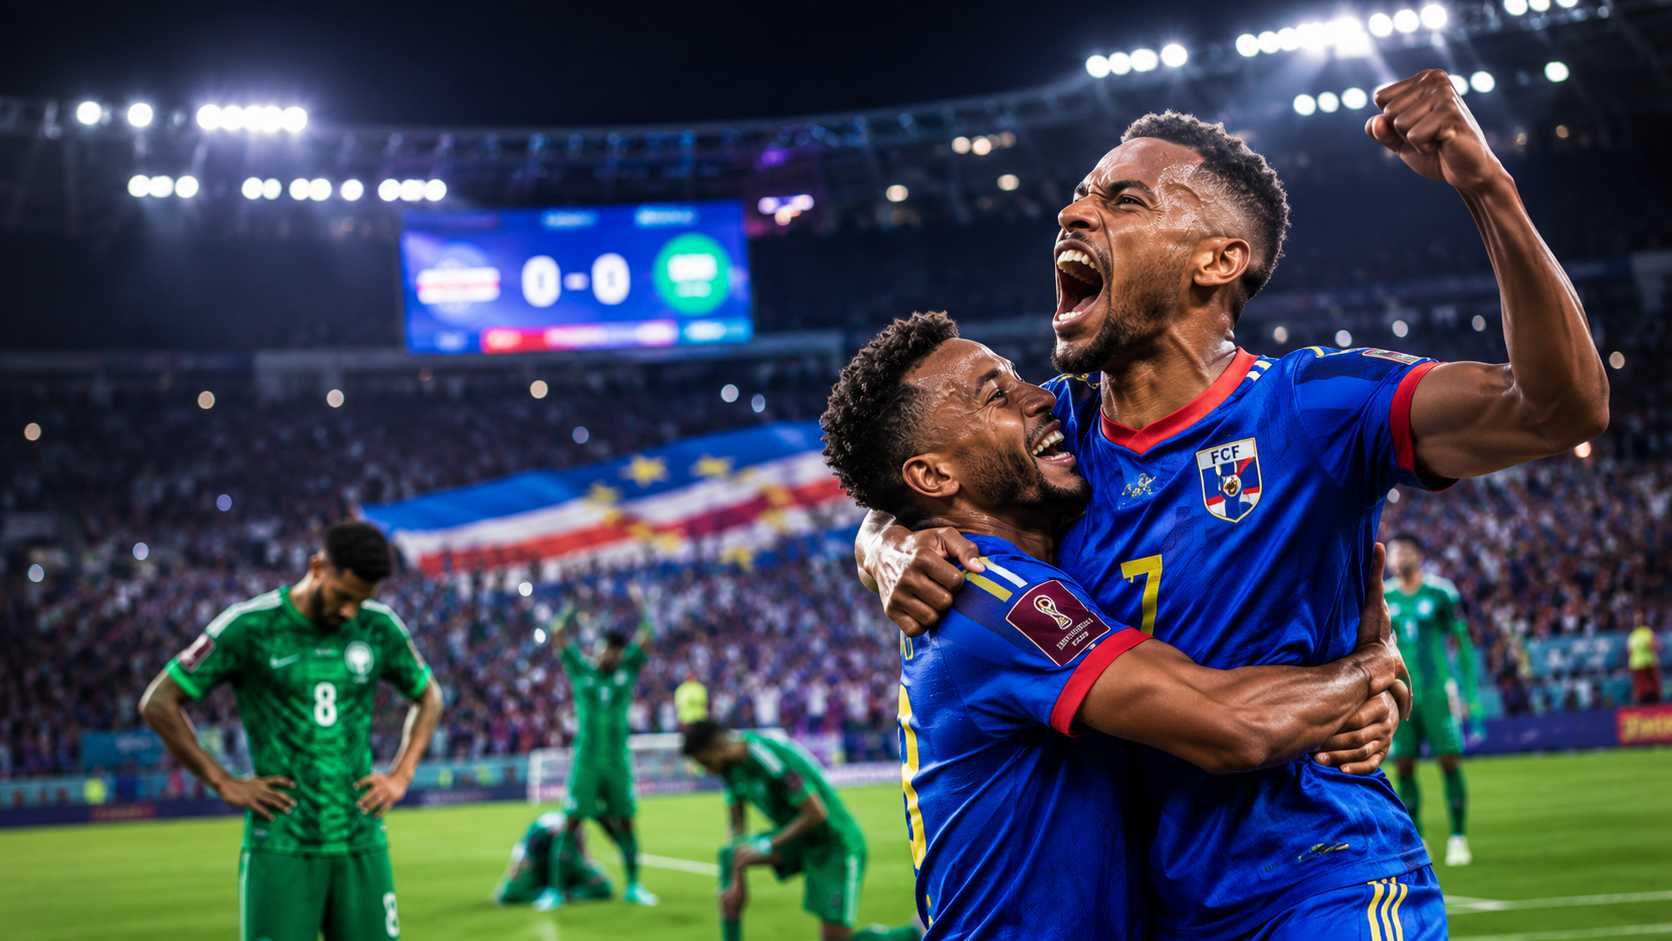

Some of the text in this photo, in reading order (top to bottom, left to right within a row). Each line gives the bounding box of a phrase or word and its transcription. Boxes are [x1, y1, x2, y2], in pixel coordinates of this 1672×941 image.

[1210, 444, 1240, 465] FCF
[1120, 554, 1163, 636] 7
[314, 682, 337, 727] 8
[383, 892, 400, 938] 8
